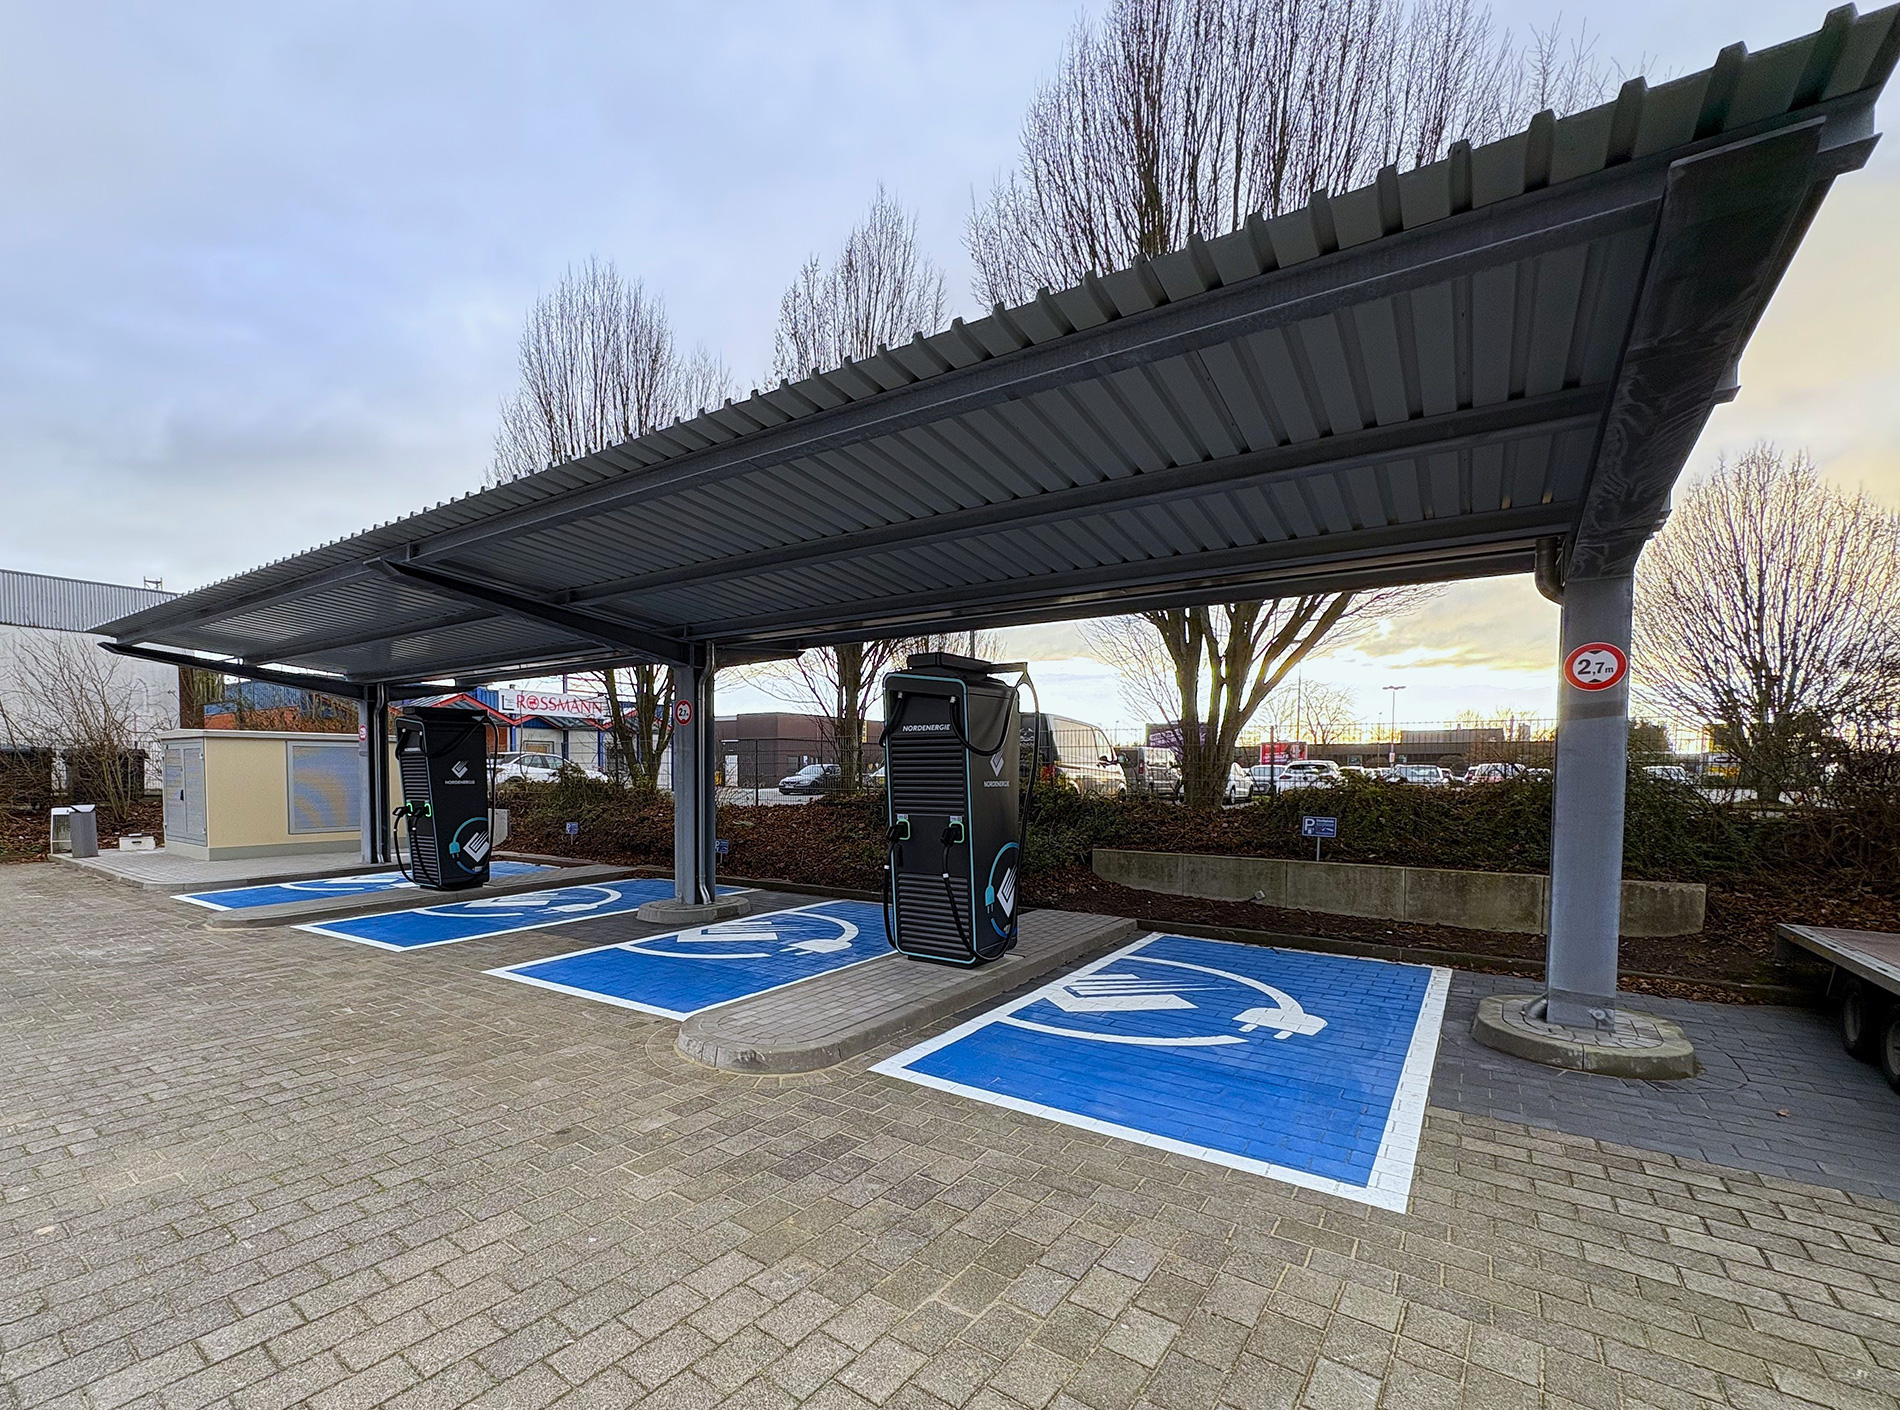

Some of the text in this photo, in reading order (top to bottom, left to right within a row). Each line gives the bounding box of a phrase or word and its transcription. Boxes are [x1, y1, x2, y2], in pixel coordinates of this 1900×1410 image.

[516, 694, 603, 714] ROSSMANN
[903, 724, 950, 732] NORDENERGIE
[1305, 819, 1315, 831] P
